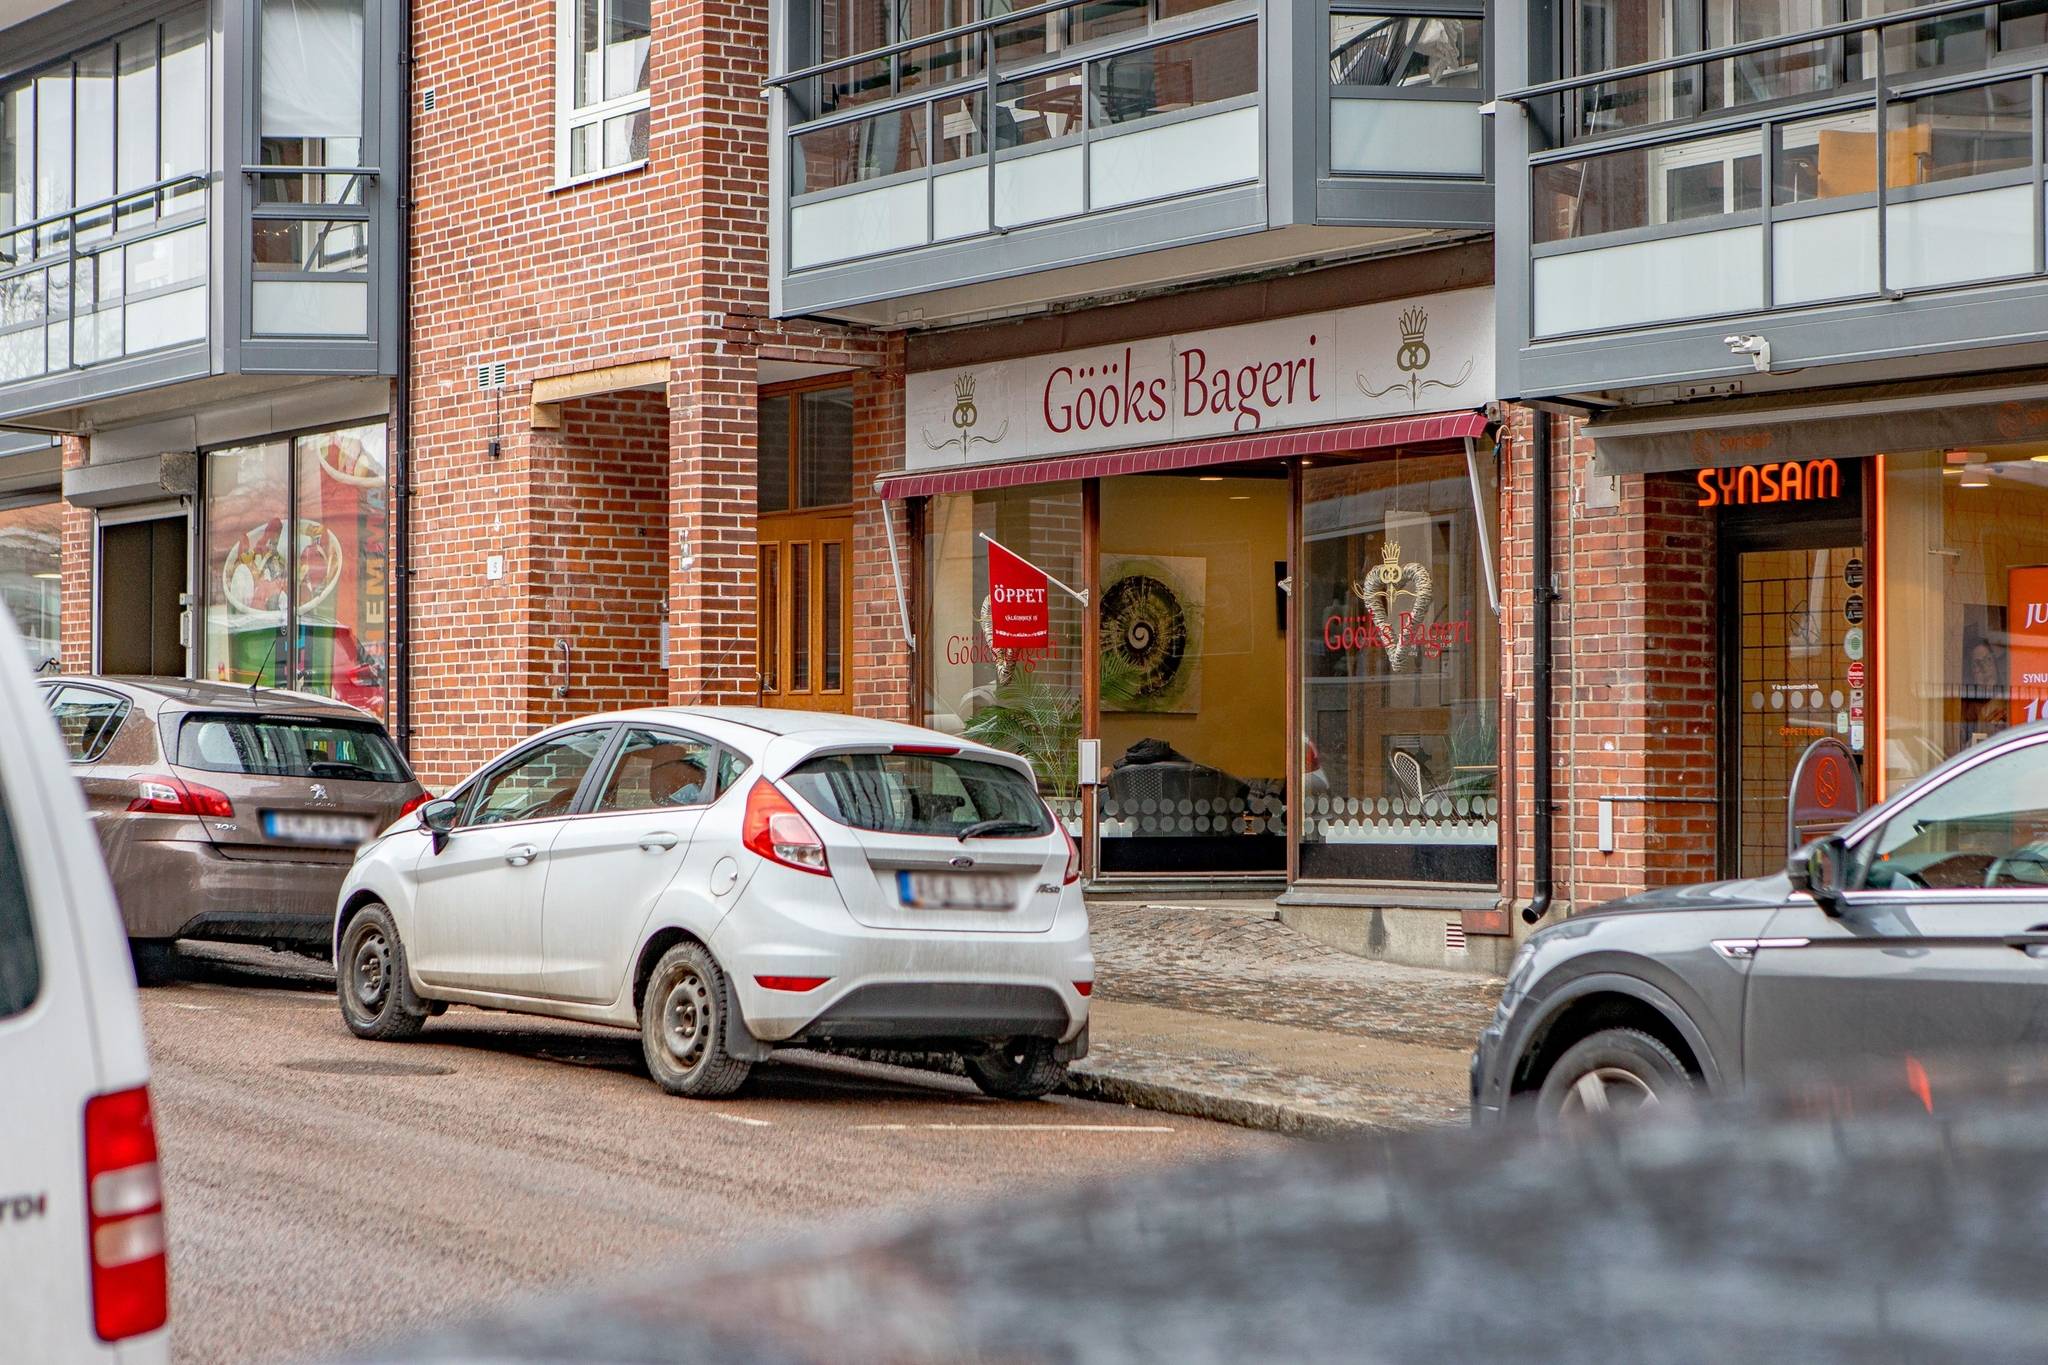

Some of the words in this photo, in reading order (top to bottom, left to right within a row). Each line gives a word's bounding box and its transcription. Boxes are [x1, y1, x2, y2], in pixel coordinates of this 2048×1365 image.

[1043, 347, 1166, 434] Gööks
[1179, 334, 1321, 432] Bageri
[1697, 458, 1839, 507] SYNSAM
[994, 584, 1045, 603] ÖPPET
